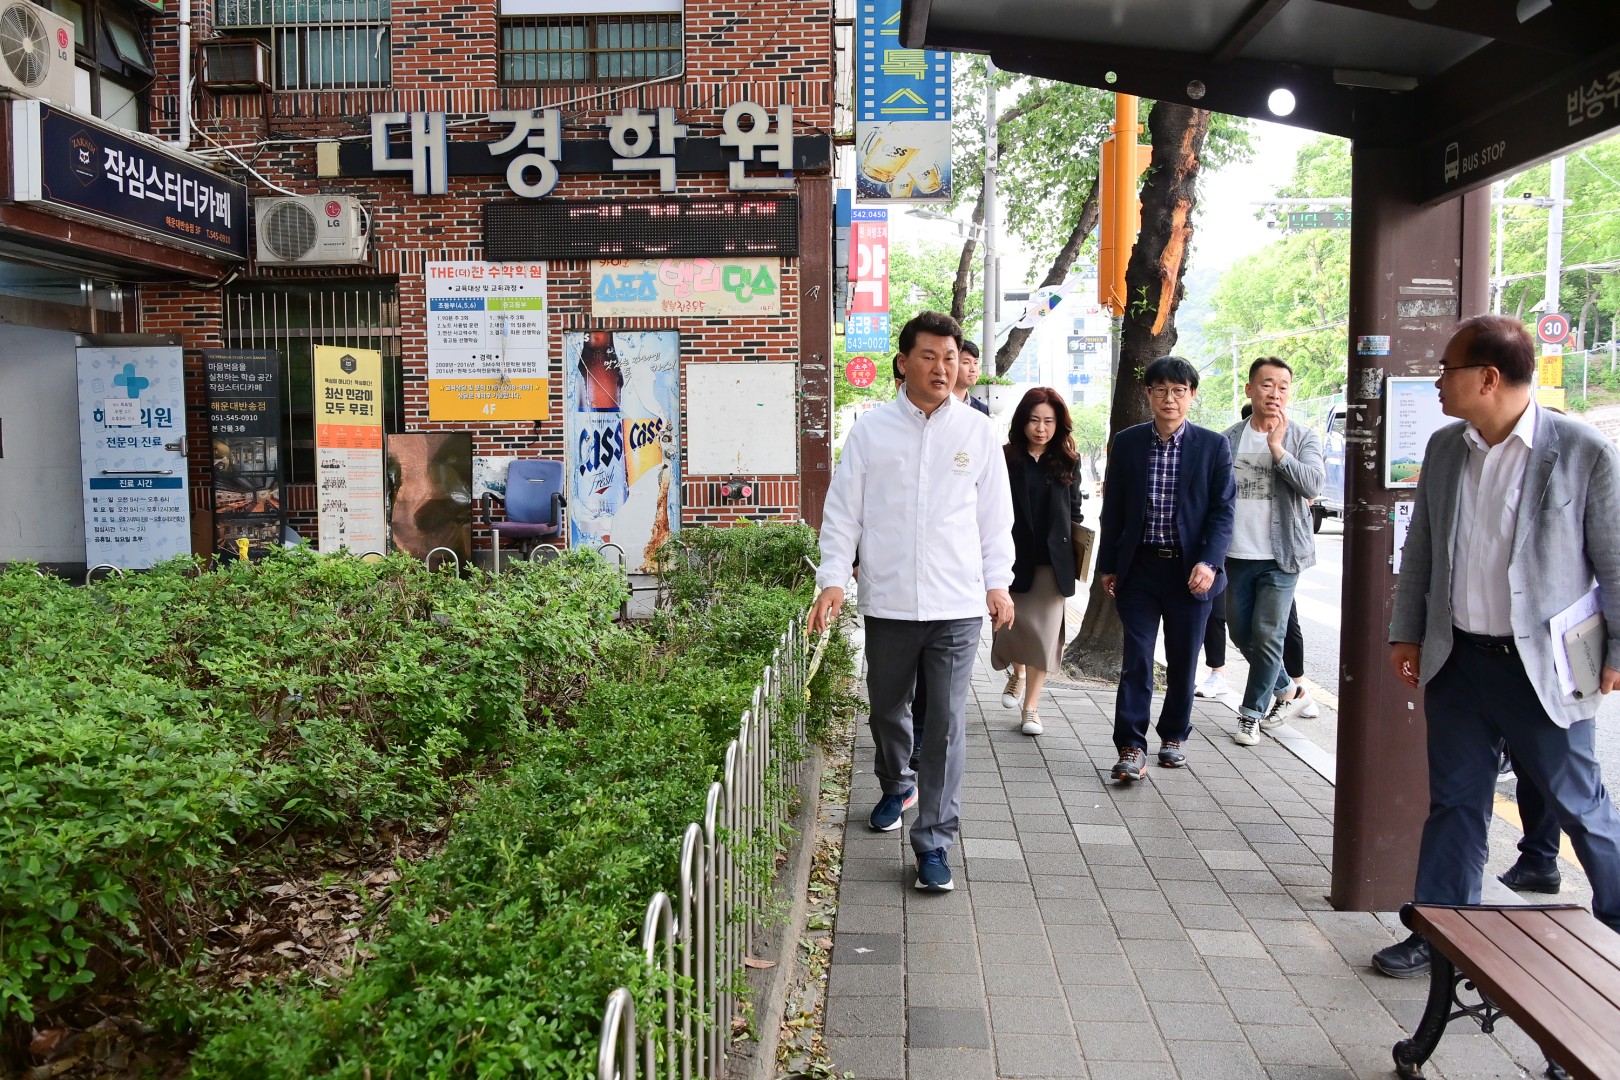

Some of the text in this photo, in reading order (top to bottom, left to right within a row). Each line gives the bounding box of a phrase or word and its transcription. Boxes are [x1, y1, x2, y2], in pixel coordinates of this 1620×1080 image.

[58, 51, 67, 61] LG
[372, 101, 795, 198] 대경학원
[1462, 140, 1506, 173] BUS STOP
[104, 147, 231, 228] 작심스터디카페
[593, 270, 659, 302] 스포츠
[722, 265, 777, 303] 댄스
[848, 316, 887, 334] 종근당약국
[1545, 322, 1561, 335] 30
[848, 337, 887, 349] 543-0027
[208, 363, 246, 372] 마음먹음을
[209, 373, 239, 381] 실천하는
[258, 373, 272, 381] 공간
[209, 384, 262, 392] 작심스터디카페
[325, 387, 372, 401] 최신 인강이
[211, 402, 266, 411] 해운대반송점
[326, 402, 373, 416] 모두 무료!
[482, 404, 496, 415] 4F
[93, 407, 172, 428] 해의원
[106, 436, 162, 448] 전문의 진료
[120, 479, 152, 488] 진료 시간
[589, 466, 615, 495] Fresh
